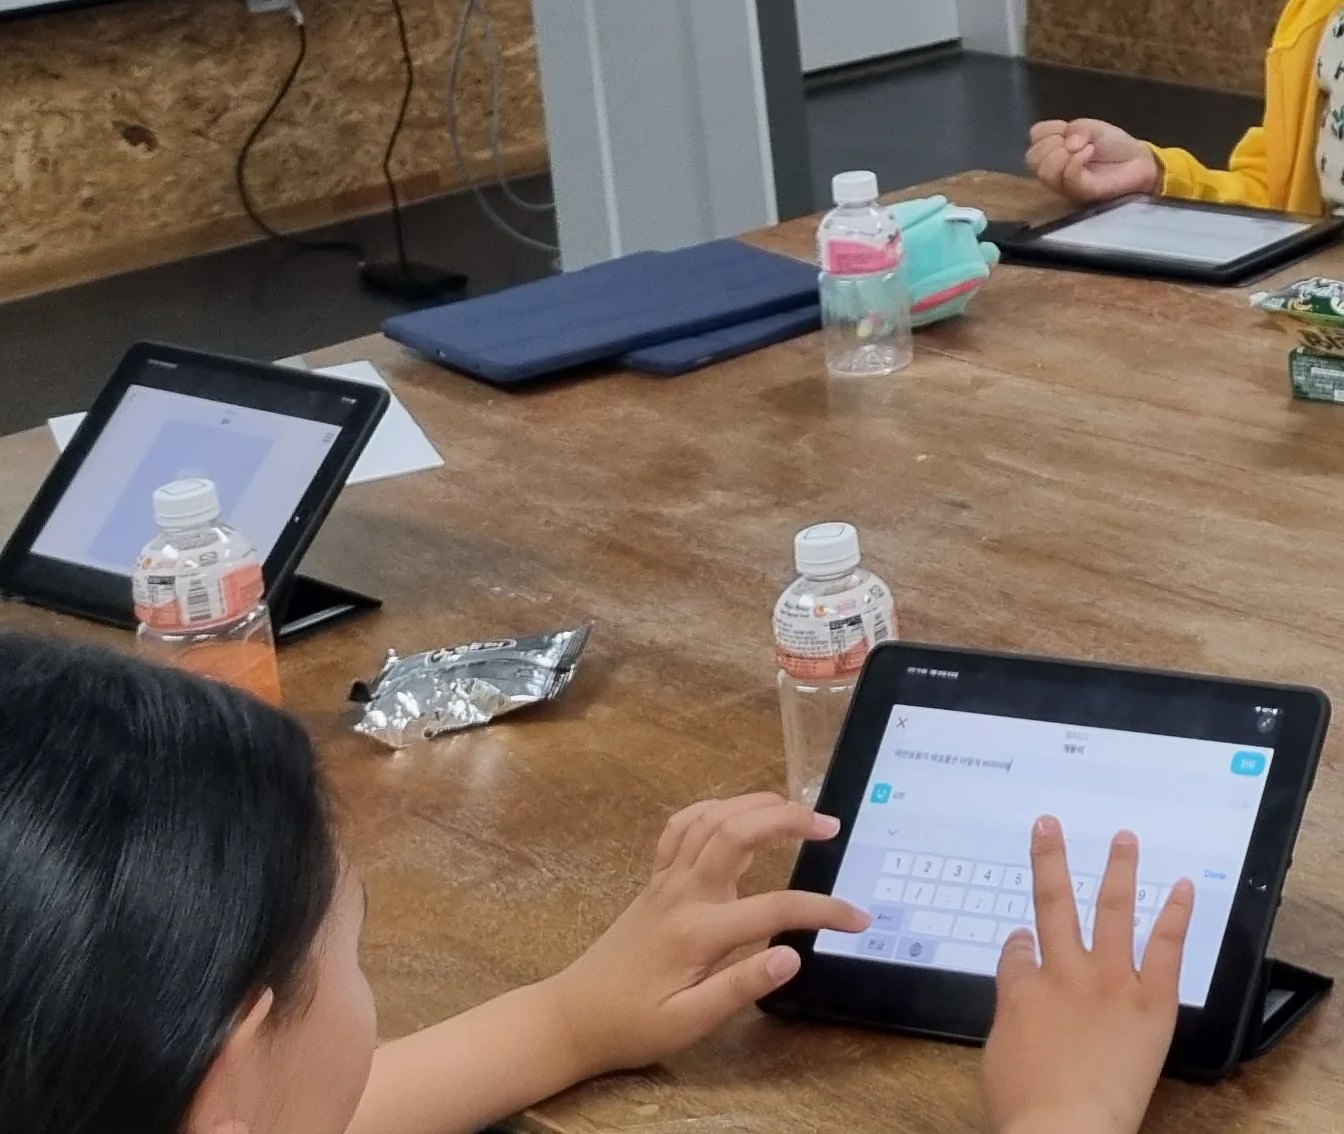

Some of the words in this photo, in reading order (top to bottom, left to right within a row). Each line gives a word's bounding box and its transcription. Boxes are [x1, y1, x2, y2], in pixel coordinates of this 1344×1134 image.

[896, 857, 902, 869] 1
[923, 861, 932, 873] 2
[953, 865, 962, 878] 3
[983, 869, 992, 882] 4
[1014, 873, 1023, 885] 5
[1076, 881, 1084, 893] 7
[1138, 889, 1146, 901] 9
